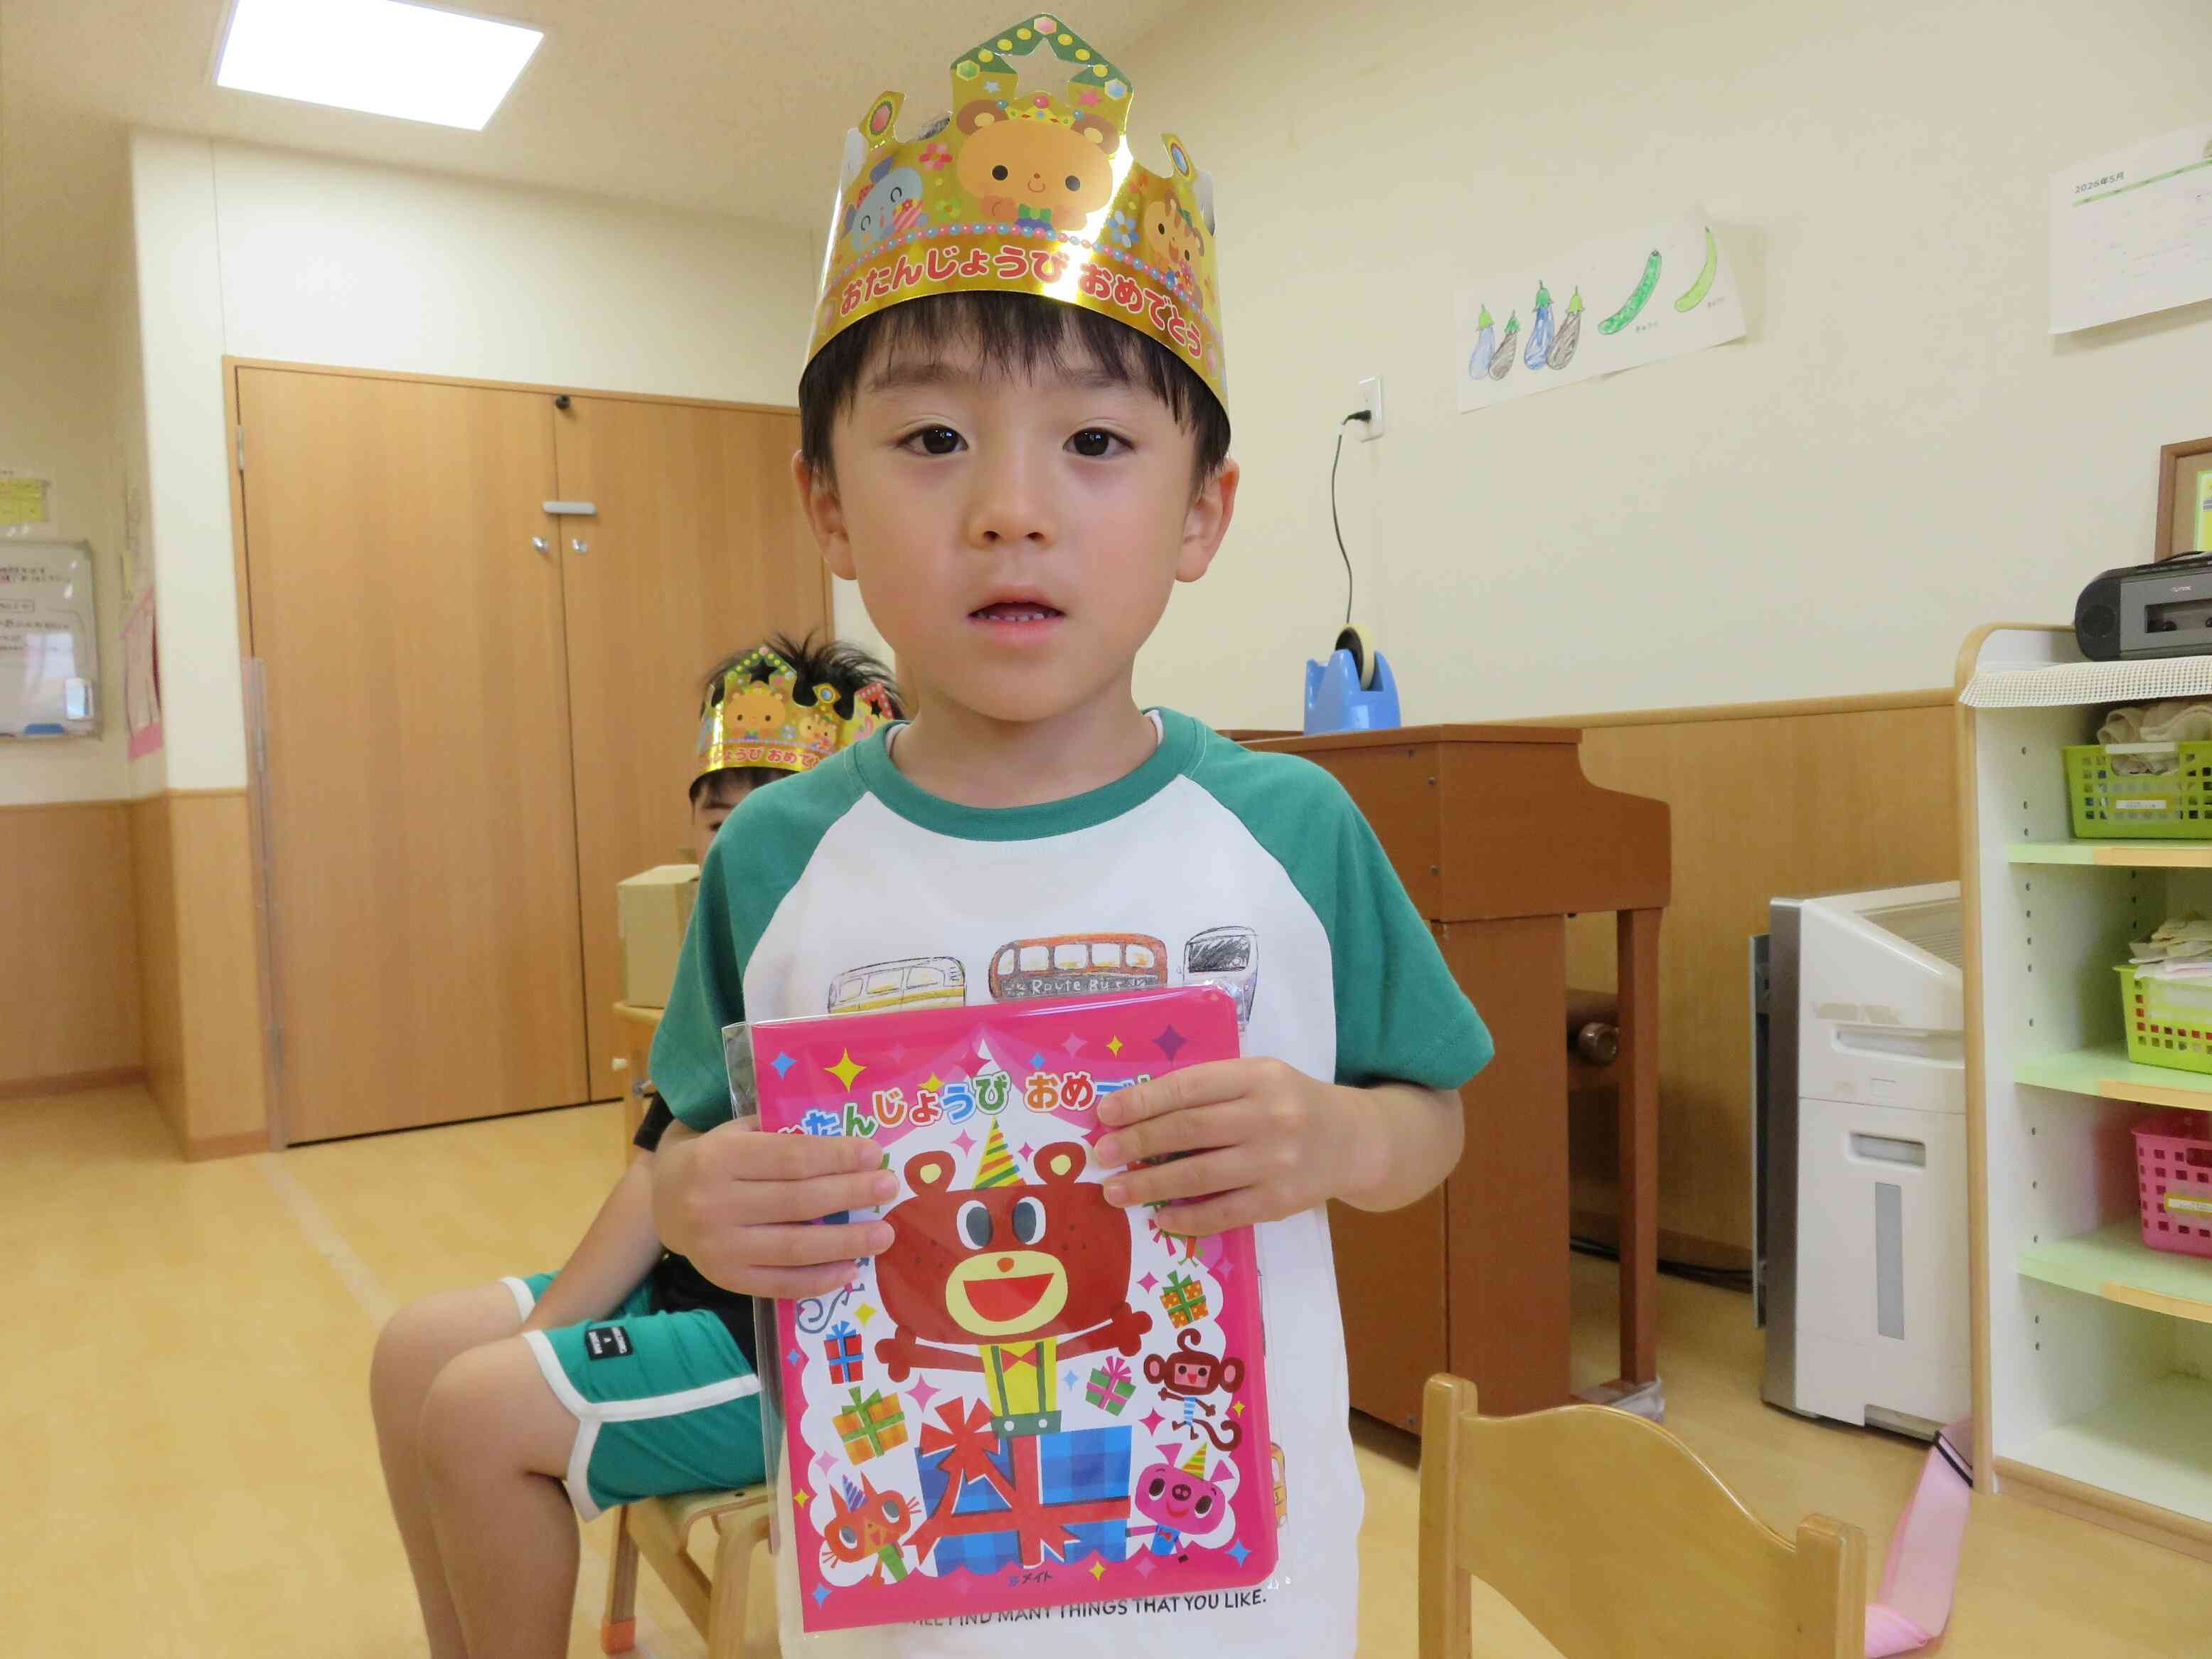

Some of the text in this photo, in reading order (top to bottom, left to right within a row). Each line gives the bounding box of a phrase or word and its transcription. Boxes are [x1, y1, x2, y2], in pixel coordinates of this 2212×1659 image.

[840, 246, 1202, 358] おたんじょうび おめでとう
[1032, 978, 1081, 996] Route
[779, 1072, 1152, 1138] たんじょうび おめ
[1021, 1570, 1053, 1584] メイト
[998, 1606, 1051, 1622] MANY
[1059, 1601, 1128, 1619] THINGS
[1133, 1596, 1180, 1614] THAT
[1184, 1594, 1219, 1611] YOU
[1224, 1589, 1267, 1609] LIKE.
